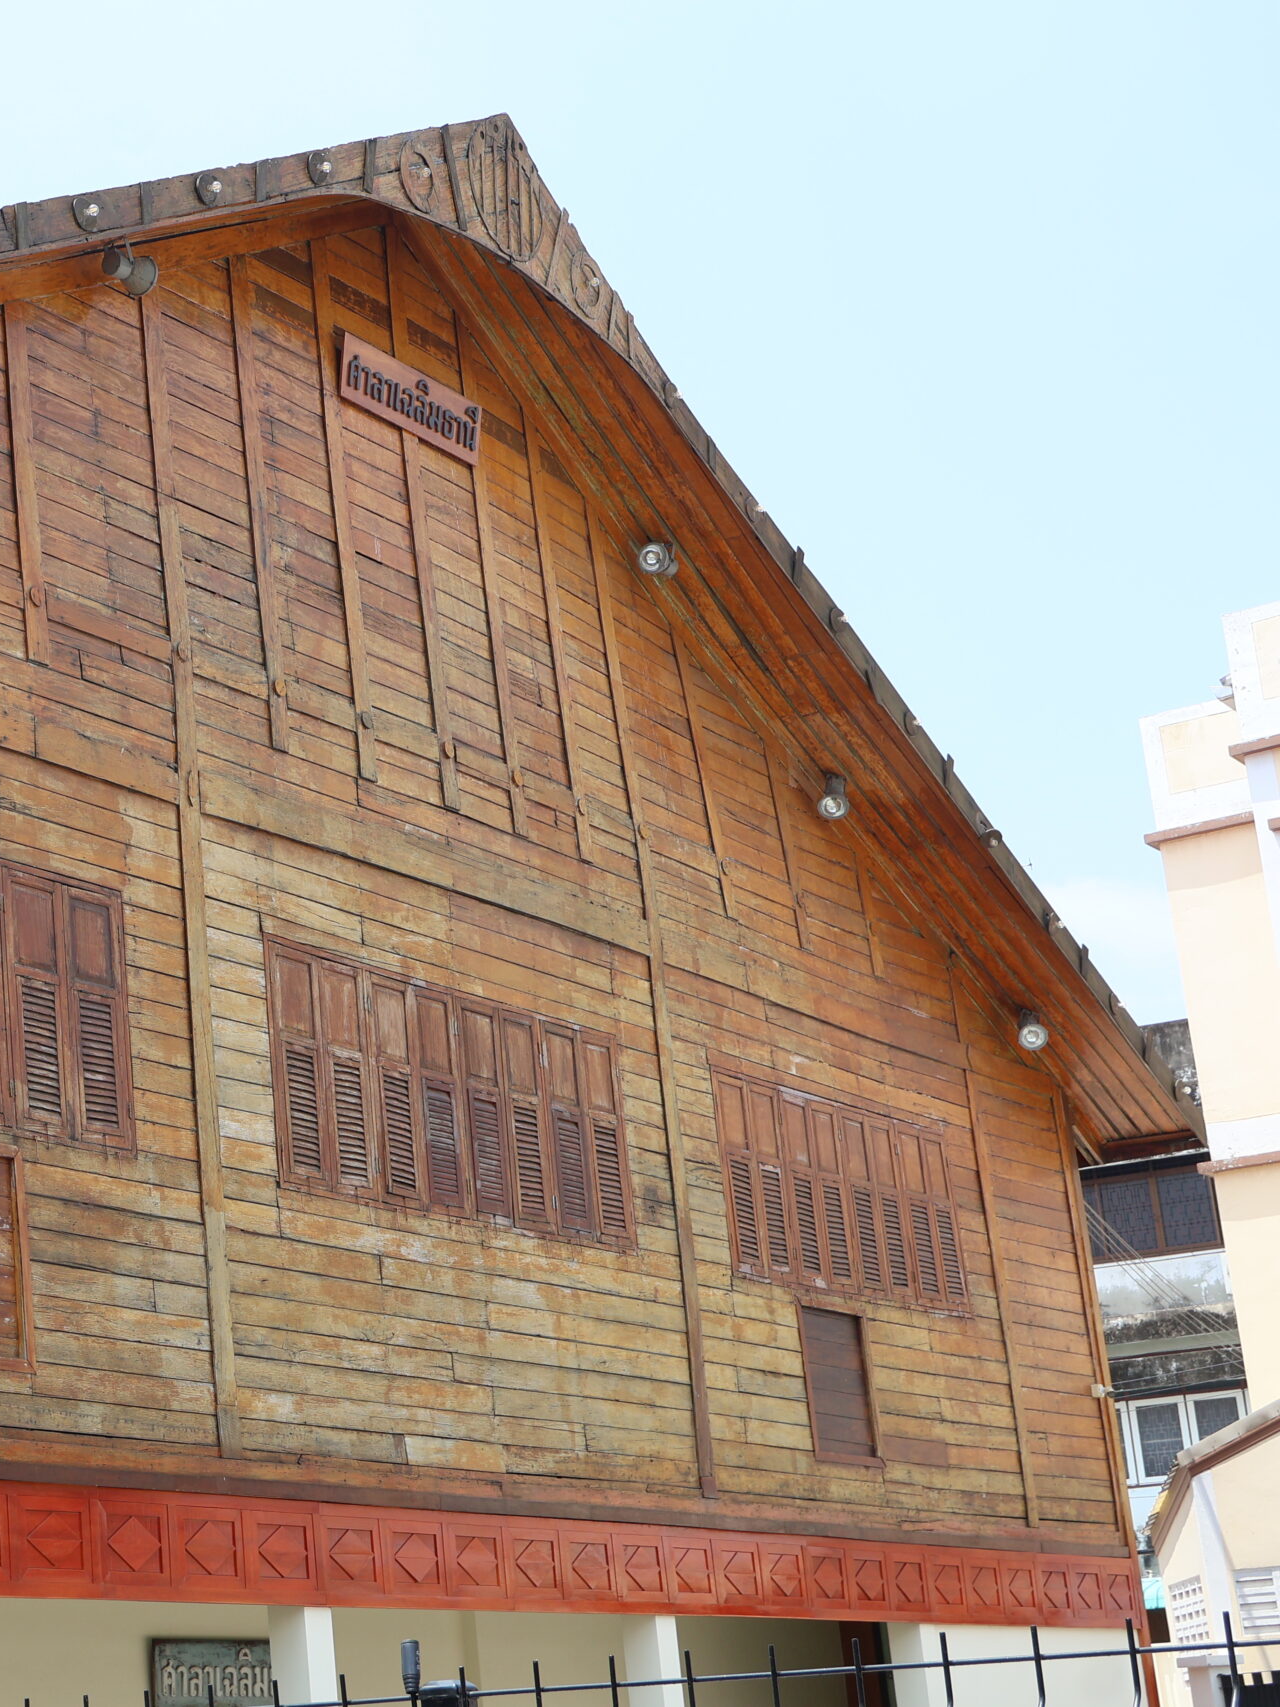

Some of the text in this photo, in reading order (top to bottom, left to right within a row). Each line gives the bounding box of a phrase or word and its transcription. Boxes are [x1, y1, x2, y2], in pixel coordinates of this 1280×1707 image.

[346, 354, 480, 452] ศาลาเฉลิมธานี
[161, 1647, 274, 1698] ศาลาเฉลิม
